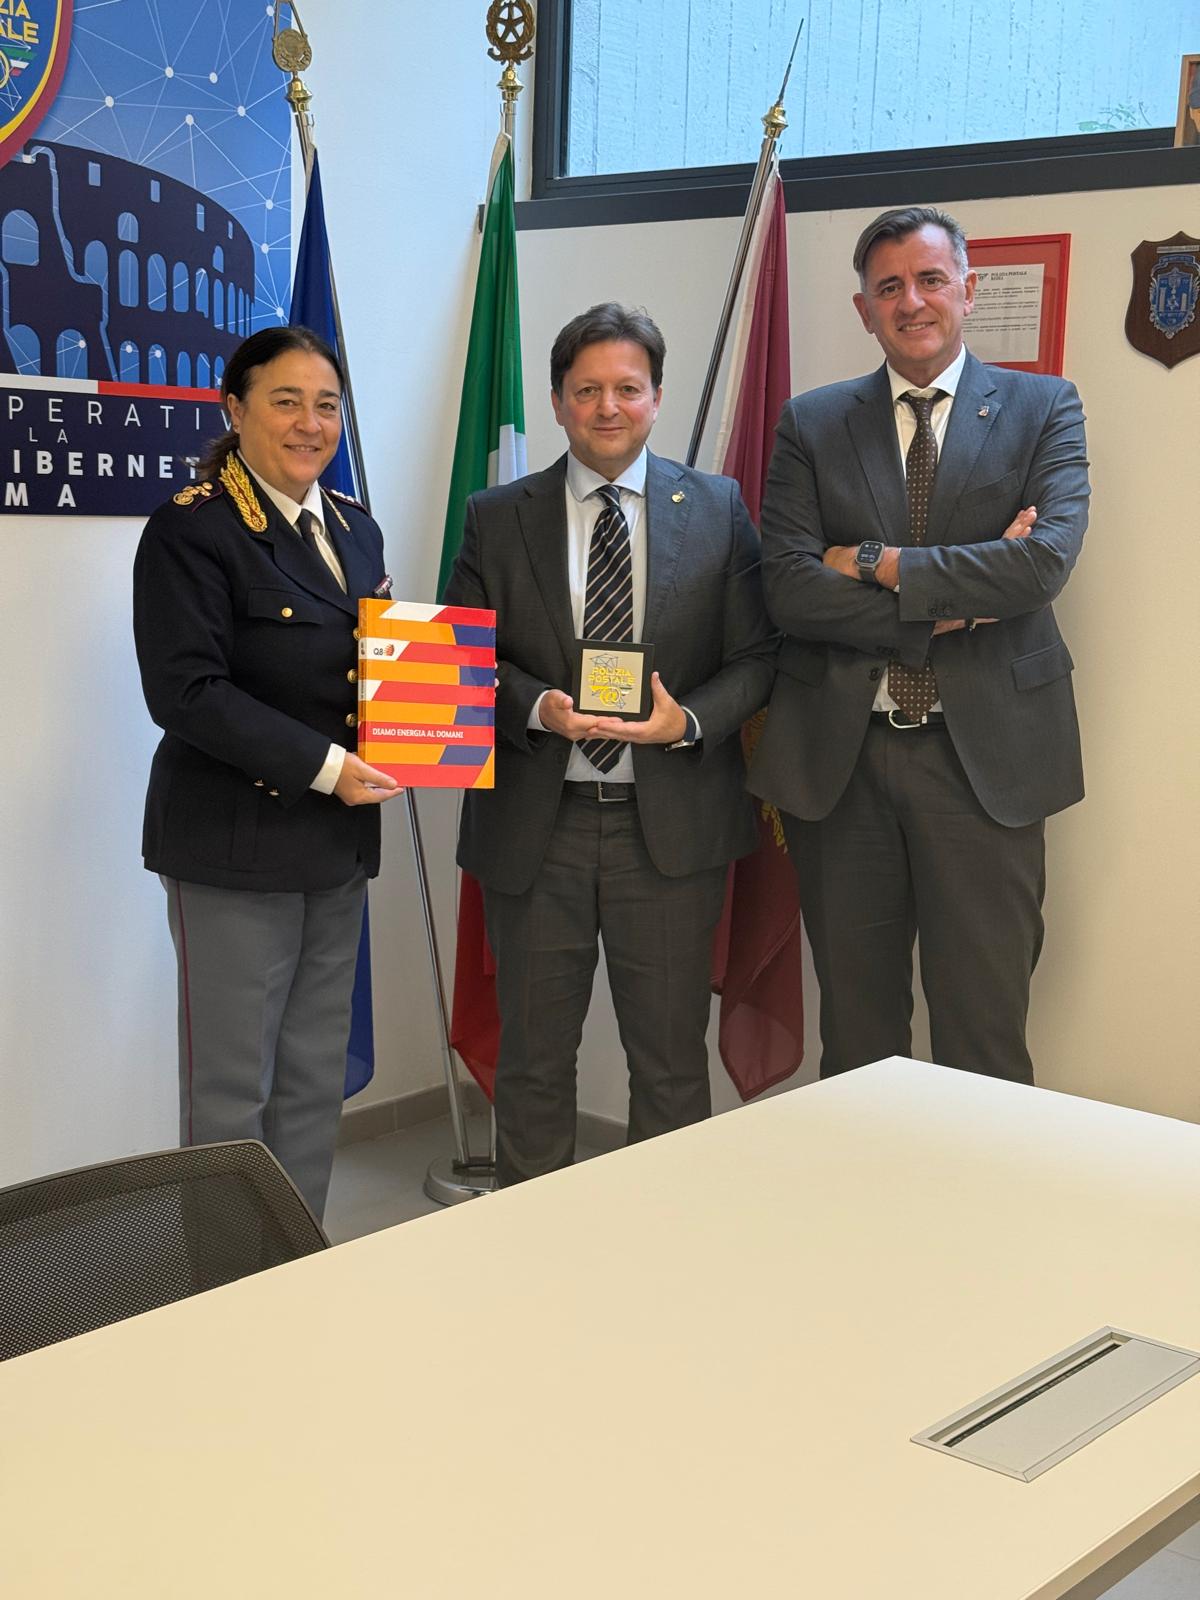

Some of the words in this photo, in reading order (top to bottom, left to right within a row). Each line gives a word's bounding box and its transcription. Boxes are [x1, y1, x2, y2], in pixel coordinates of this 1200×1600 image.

[28, 426, 69, 444] LA
[4, 482, 77, 508] MA
[373, 647, 384, 656] Q8
[372, 728, 396, 736] DIAMO
[397, 729, 426, 737] ENERGIA
[426, 730, 436, 738] AL
[436, 731, 464, 739] DOMANI
